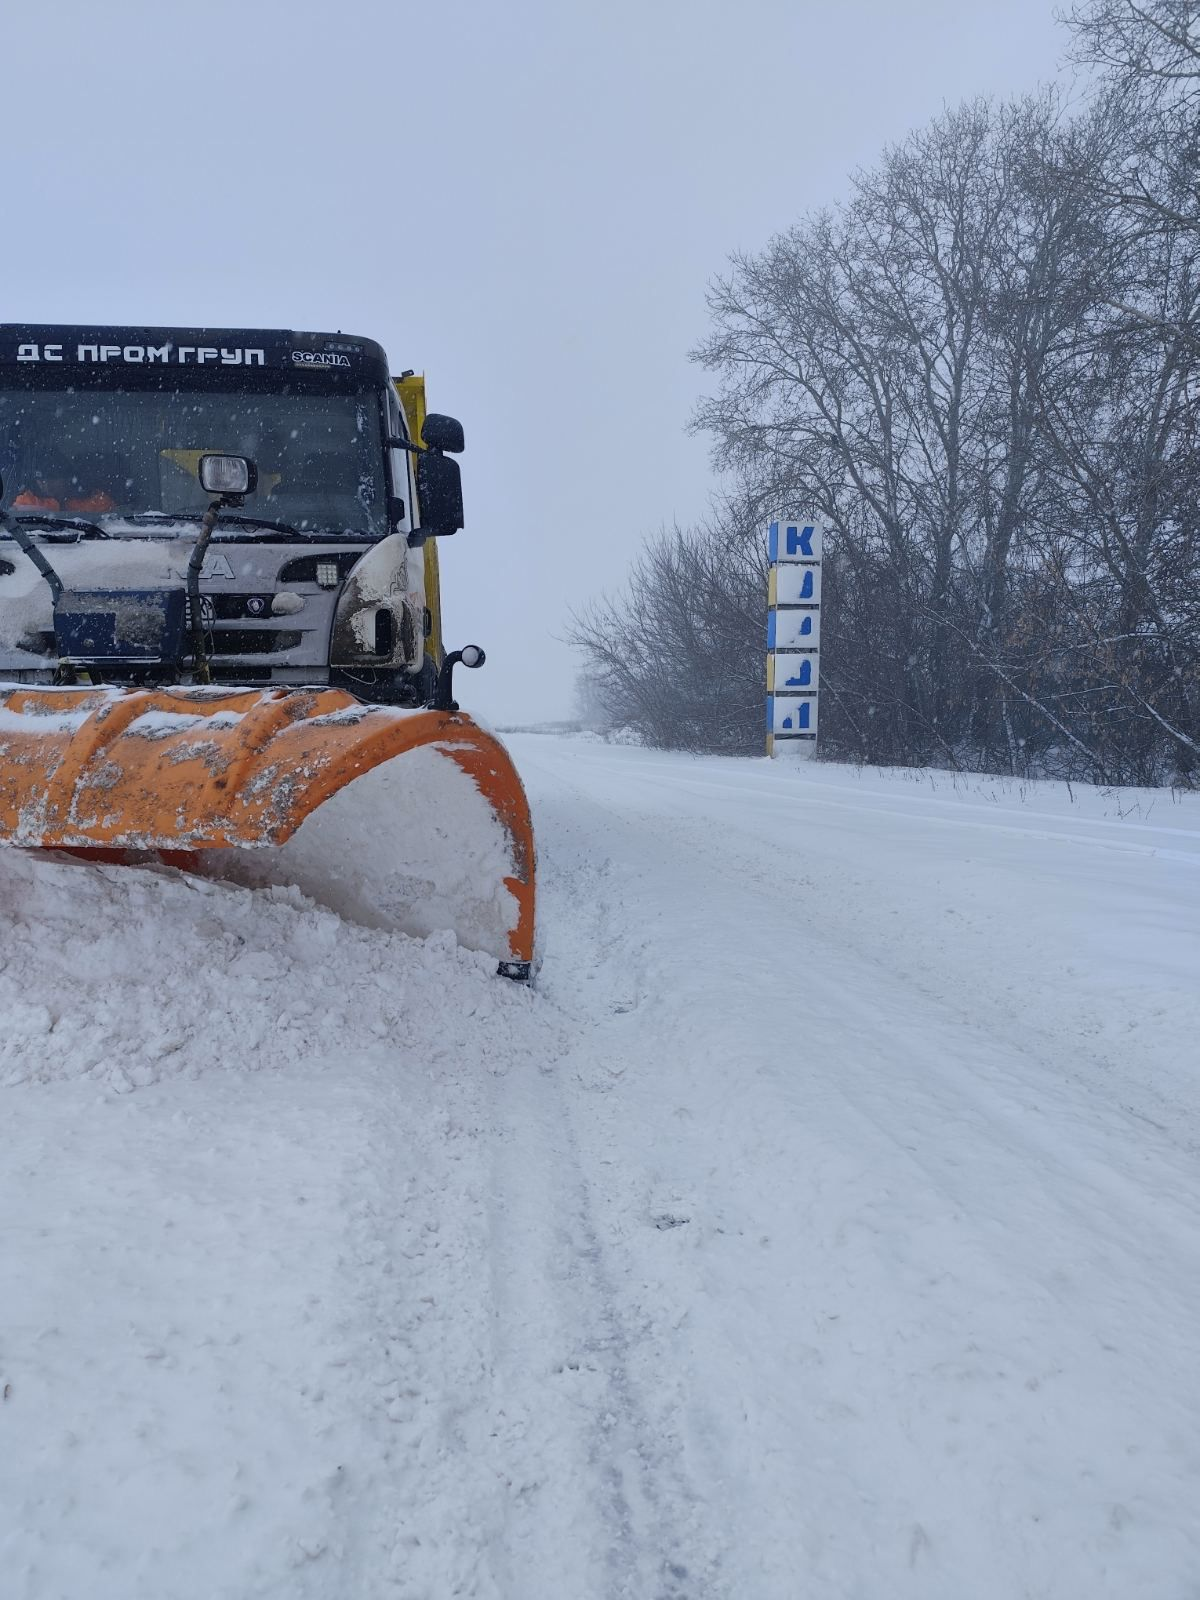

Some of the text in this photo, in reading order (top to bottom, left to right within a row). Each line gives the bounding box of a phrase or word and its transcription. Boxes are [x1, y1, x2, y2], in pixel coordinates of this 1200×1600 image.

[17, 344, 265, 366] ДС ПРОМ ГРУП
[291, 351, 351, 367] SCANIA
